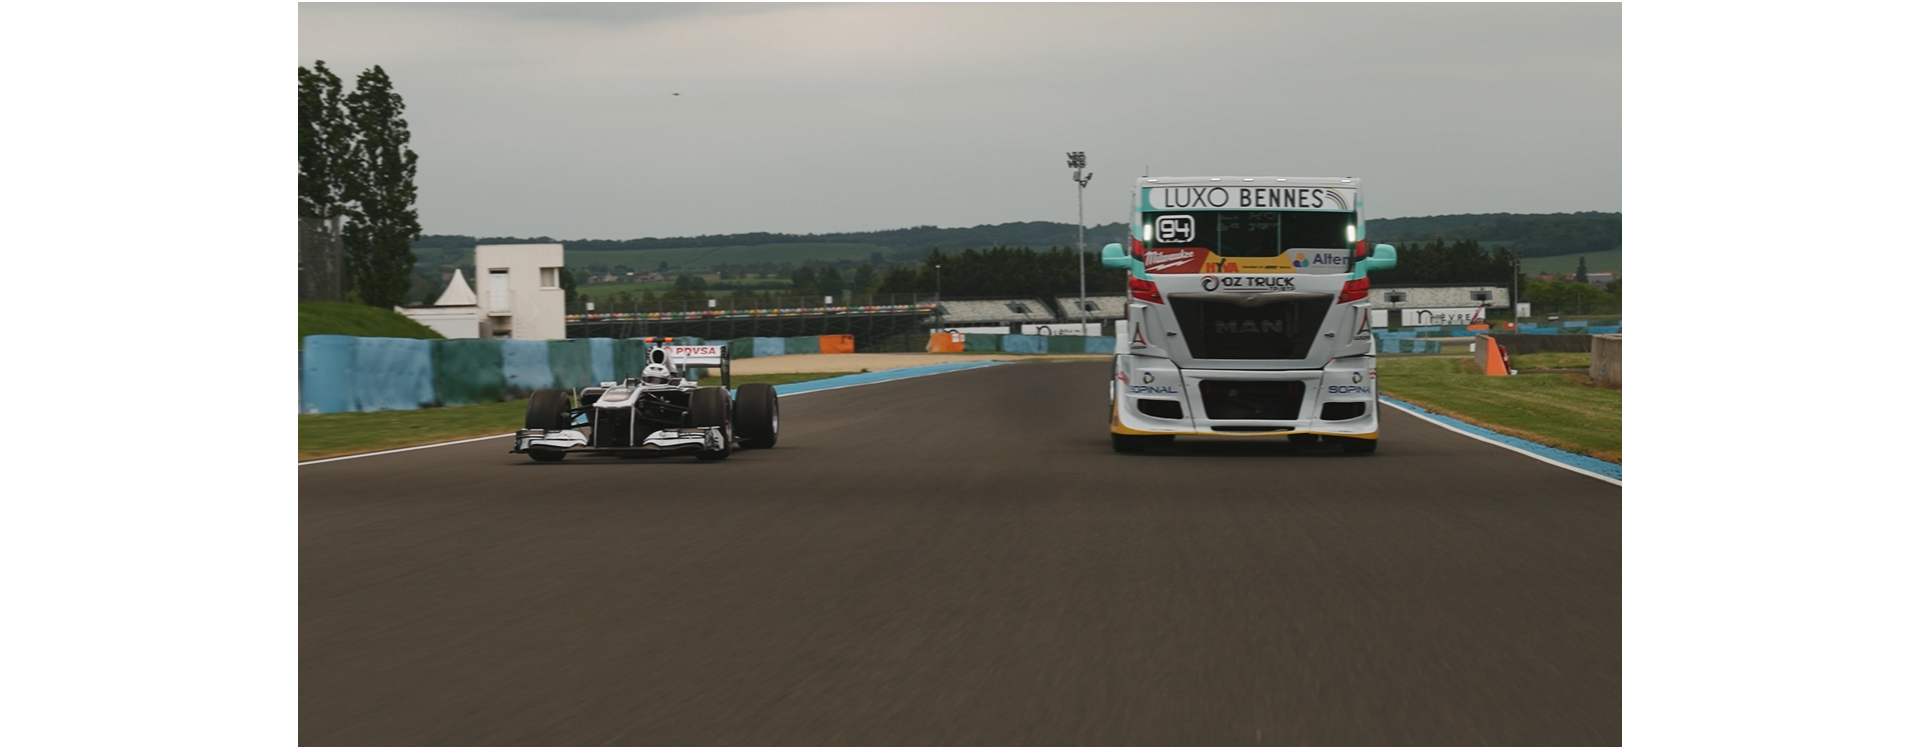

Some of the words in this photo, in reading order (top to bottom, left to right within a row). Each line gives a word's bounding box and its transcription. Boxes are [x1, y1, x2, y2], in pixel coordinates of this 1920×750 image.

[1165, 187, 1229, 208] LUXO
[1240, 188, 1324, 208] BENNES
[1160, 219, 1190, 238] 94
[1205, 258, 1239, 273] HYVA
[1246, 277, 1295, 287] TRUCK
[1215, 319, 1284, 333] MAN
[676, 347, 717, 355] PDVSA
[1130, 385, 1178, 394] SOPINAL
